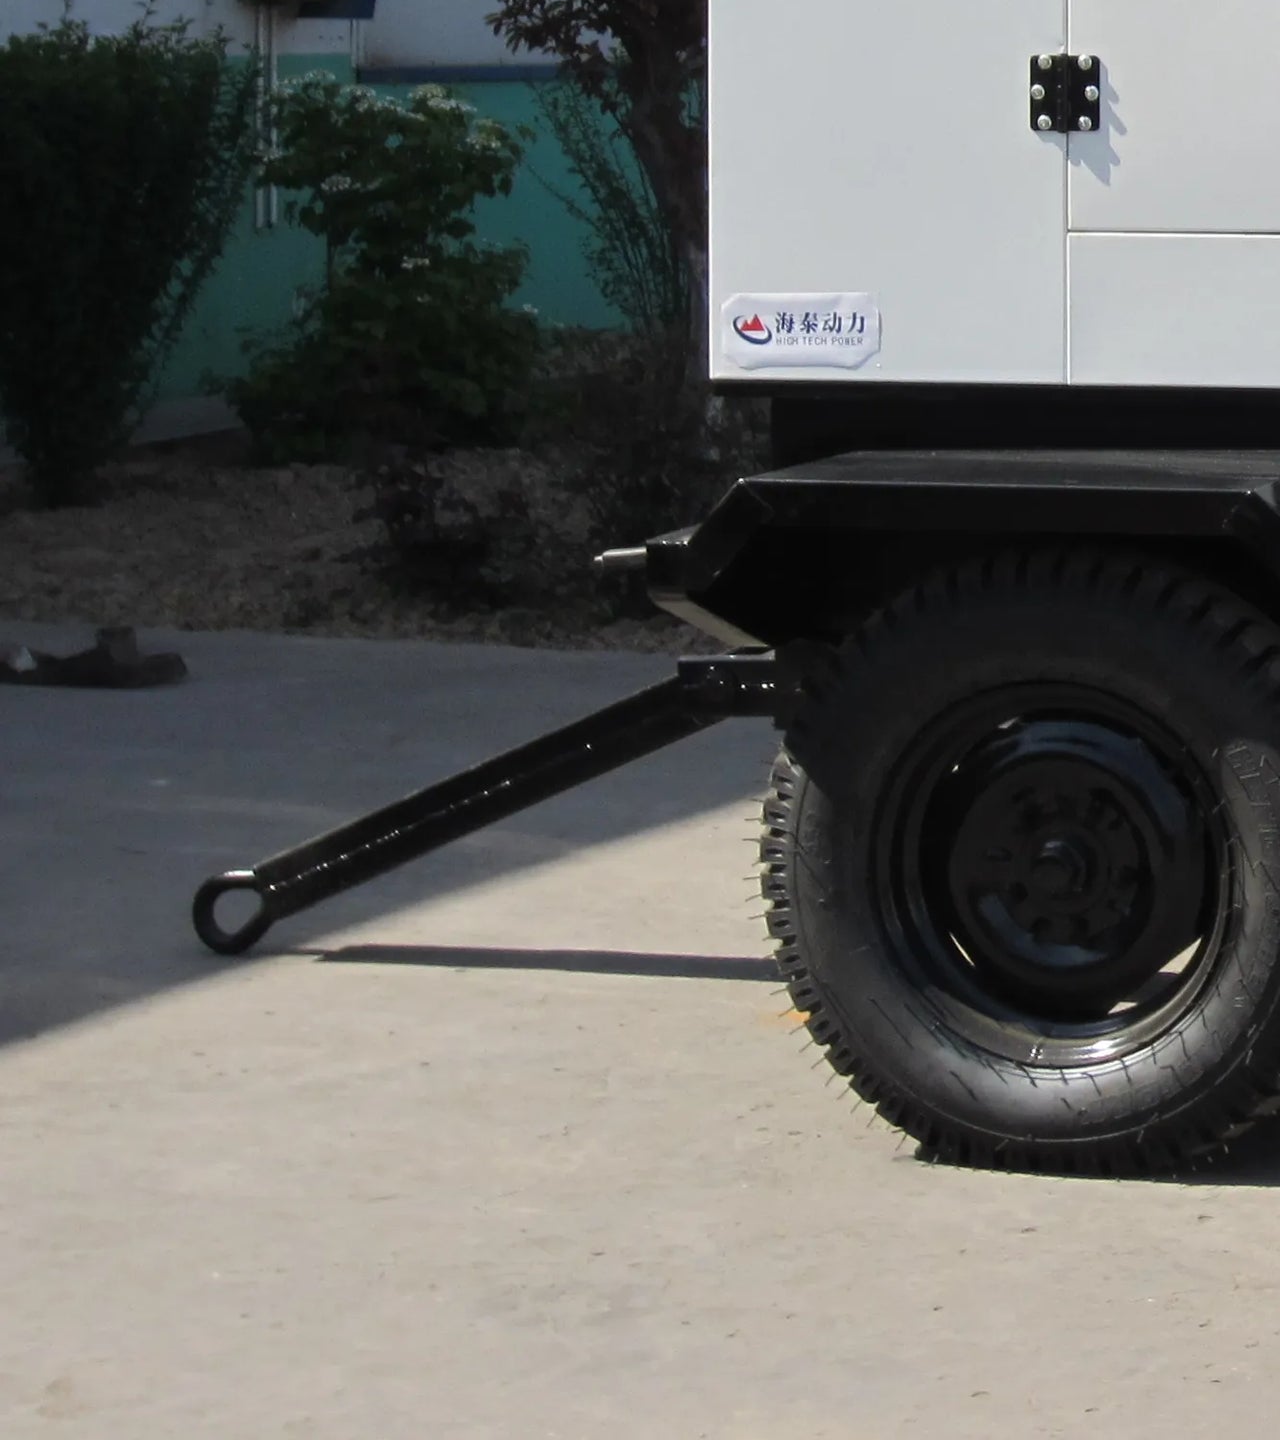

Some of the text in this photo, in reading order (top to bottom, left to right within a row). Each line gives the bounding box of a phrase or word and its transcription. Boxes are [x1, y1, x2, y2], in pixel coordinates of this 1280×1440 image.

[775, 336, 864, 346] HIGH TECH POWER
